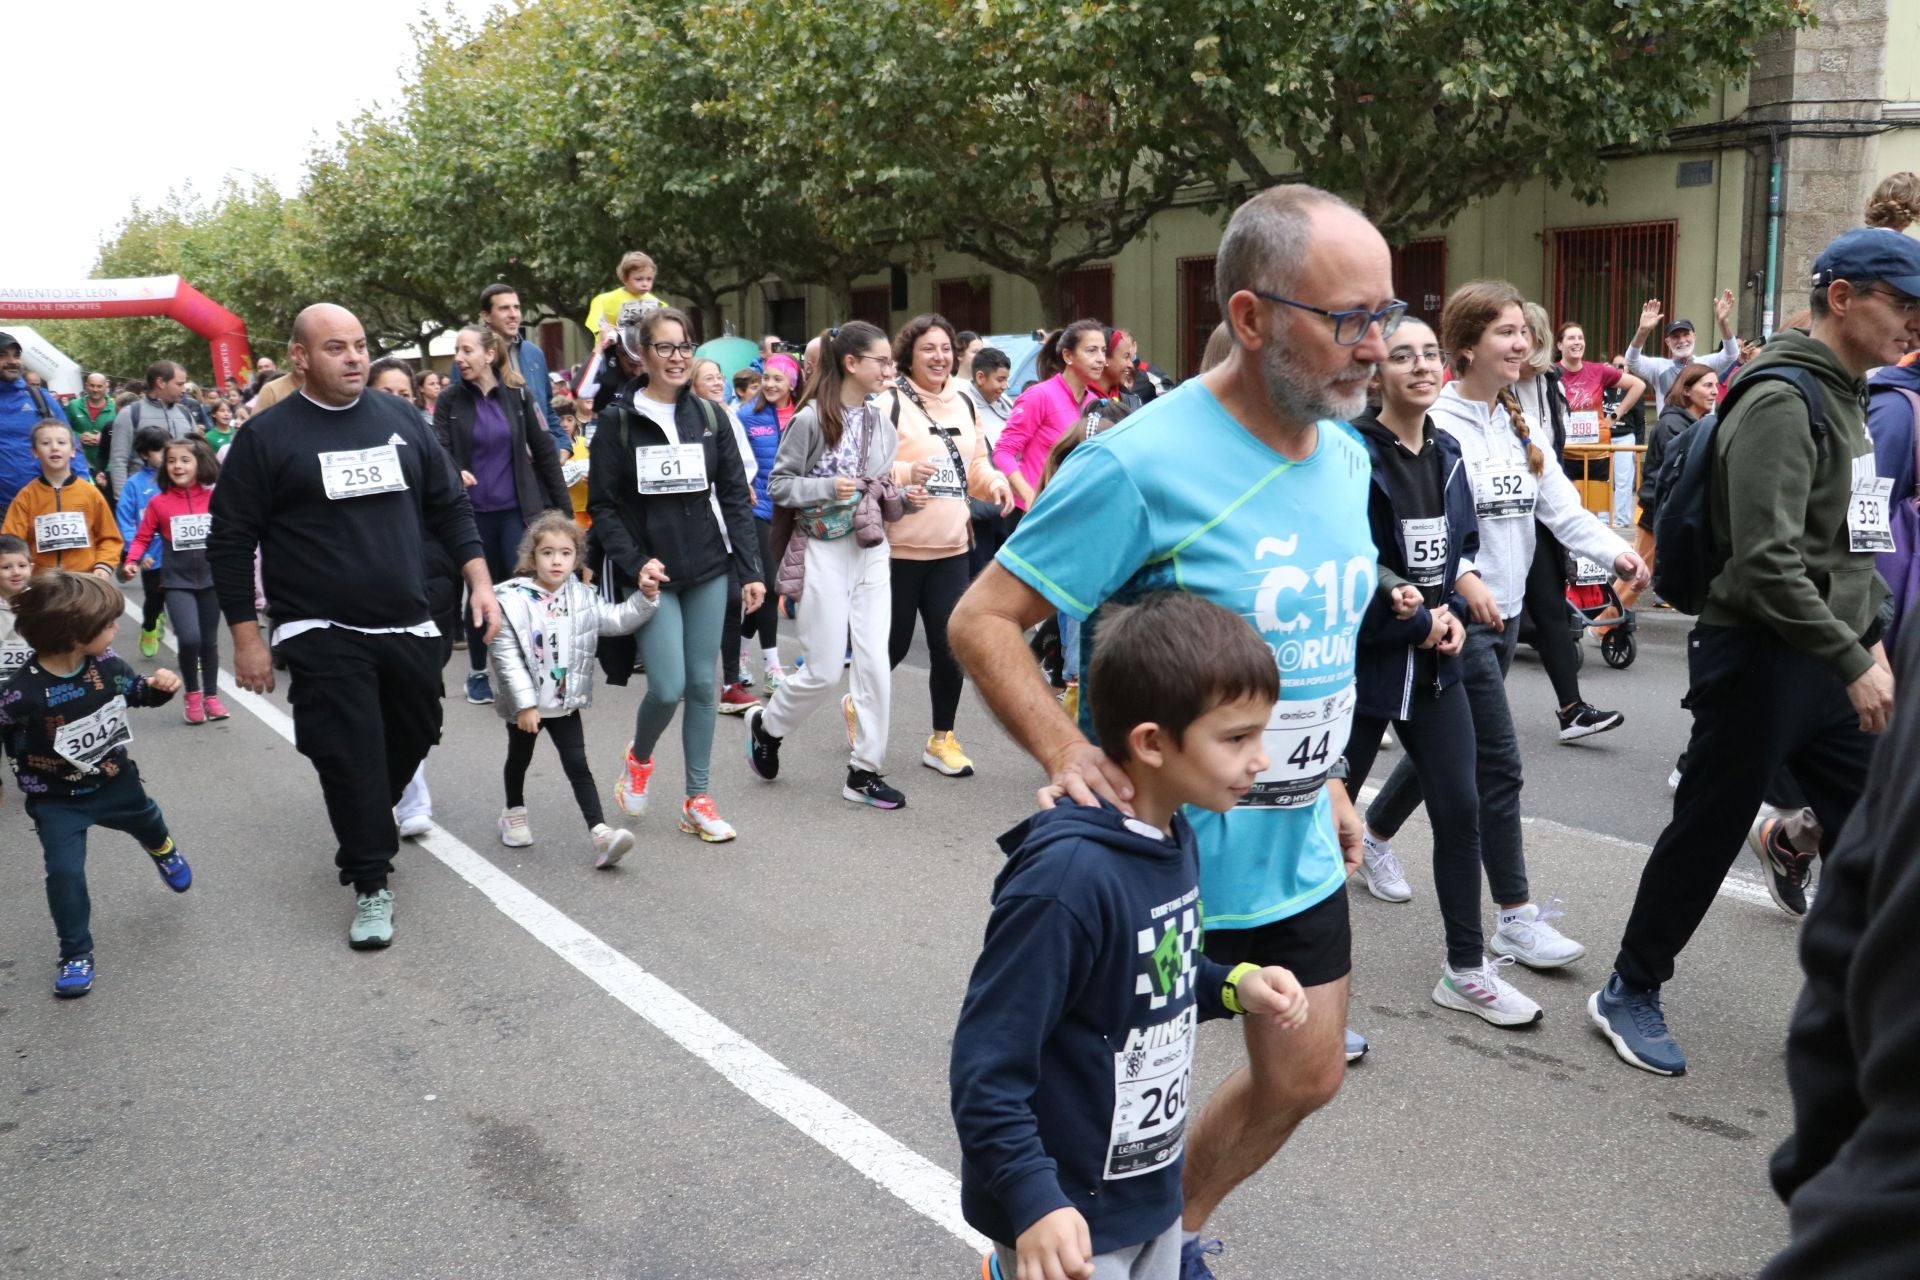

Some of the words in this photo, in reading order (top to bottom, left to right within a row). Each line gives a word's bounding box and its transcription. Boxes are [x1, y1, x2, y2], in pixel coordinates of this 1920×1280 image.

[66, 287, 81, 298] DE
[1572, 423, 1591, 435] 898
[341, 465, 382, 486] 258
[660, 459, 682, 476] 61
[1492, 475, 1522, 496] 552
[1859, 500, 1879, 525] 339
[43, 523, 79, 538] 3052
[1413, 537, 1447, 562] 553
[67, 717, 118, 756] 3042
[1287, 730, 1330, 769] 44
[1138, 1068, 1189, 1130] 260
